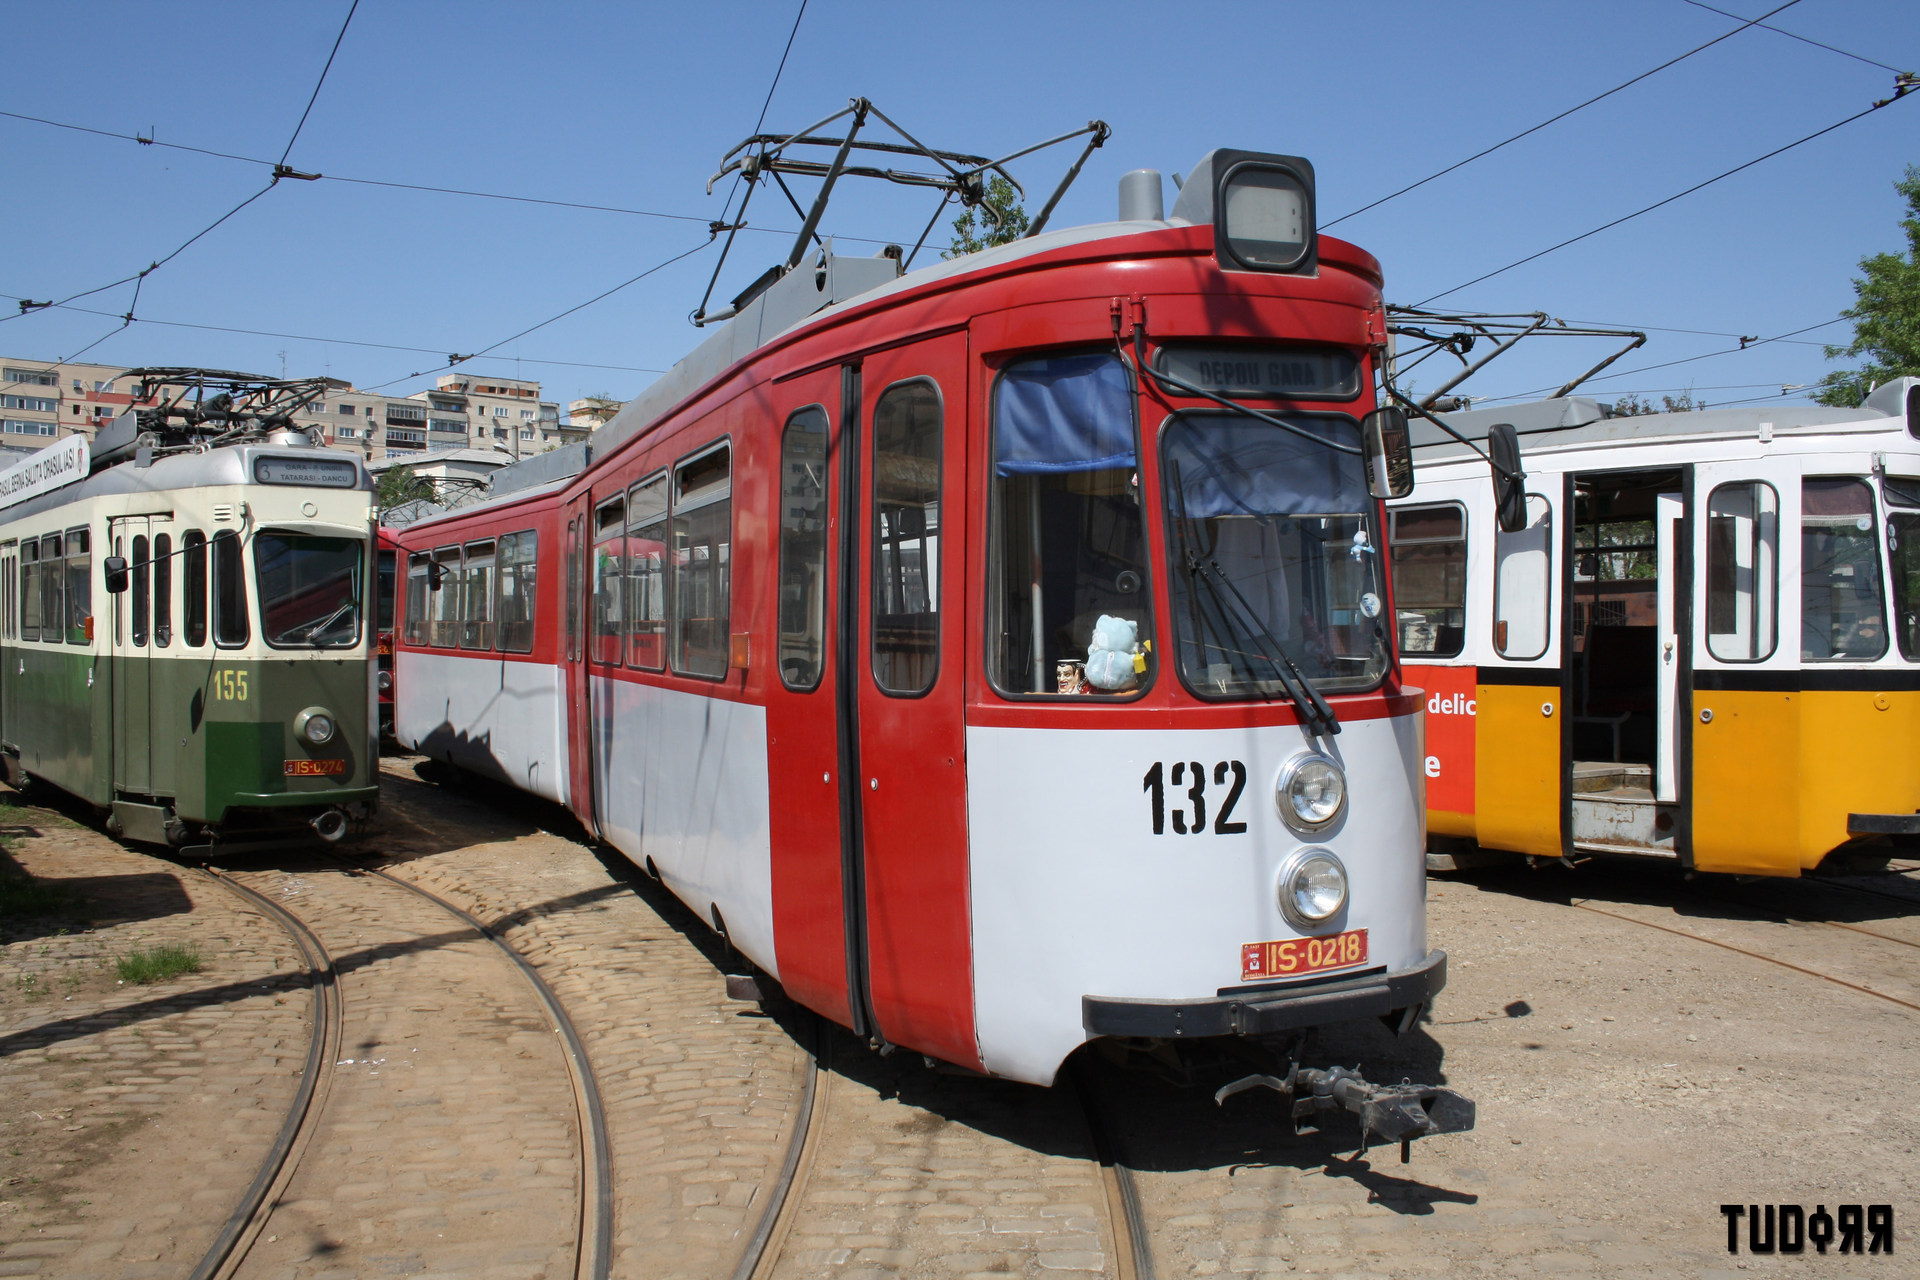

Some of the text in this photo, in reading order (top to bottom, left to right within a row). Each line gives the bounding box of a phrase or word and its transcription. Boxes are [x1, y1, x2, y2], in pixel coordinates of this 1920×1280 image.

[1200, 360, 1316, 387] DEPOU GARA
[260, 464, 271, 480] 3
[322, 475, 348, 483] DANCU
[214, 669, 248, 701] 155
[1427, 693, 1476, 715] delic
[1143, 760, 1247, 835] 132
[1271, 933, 1361, 973] IS-0218
